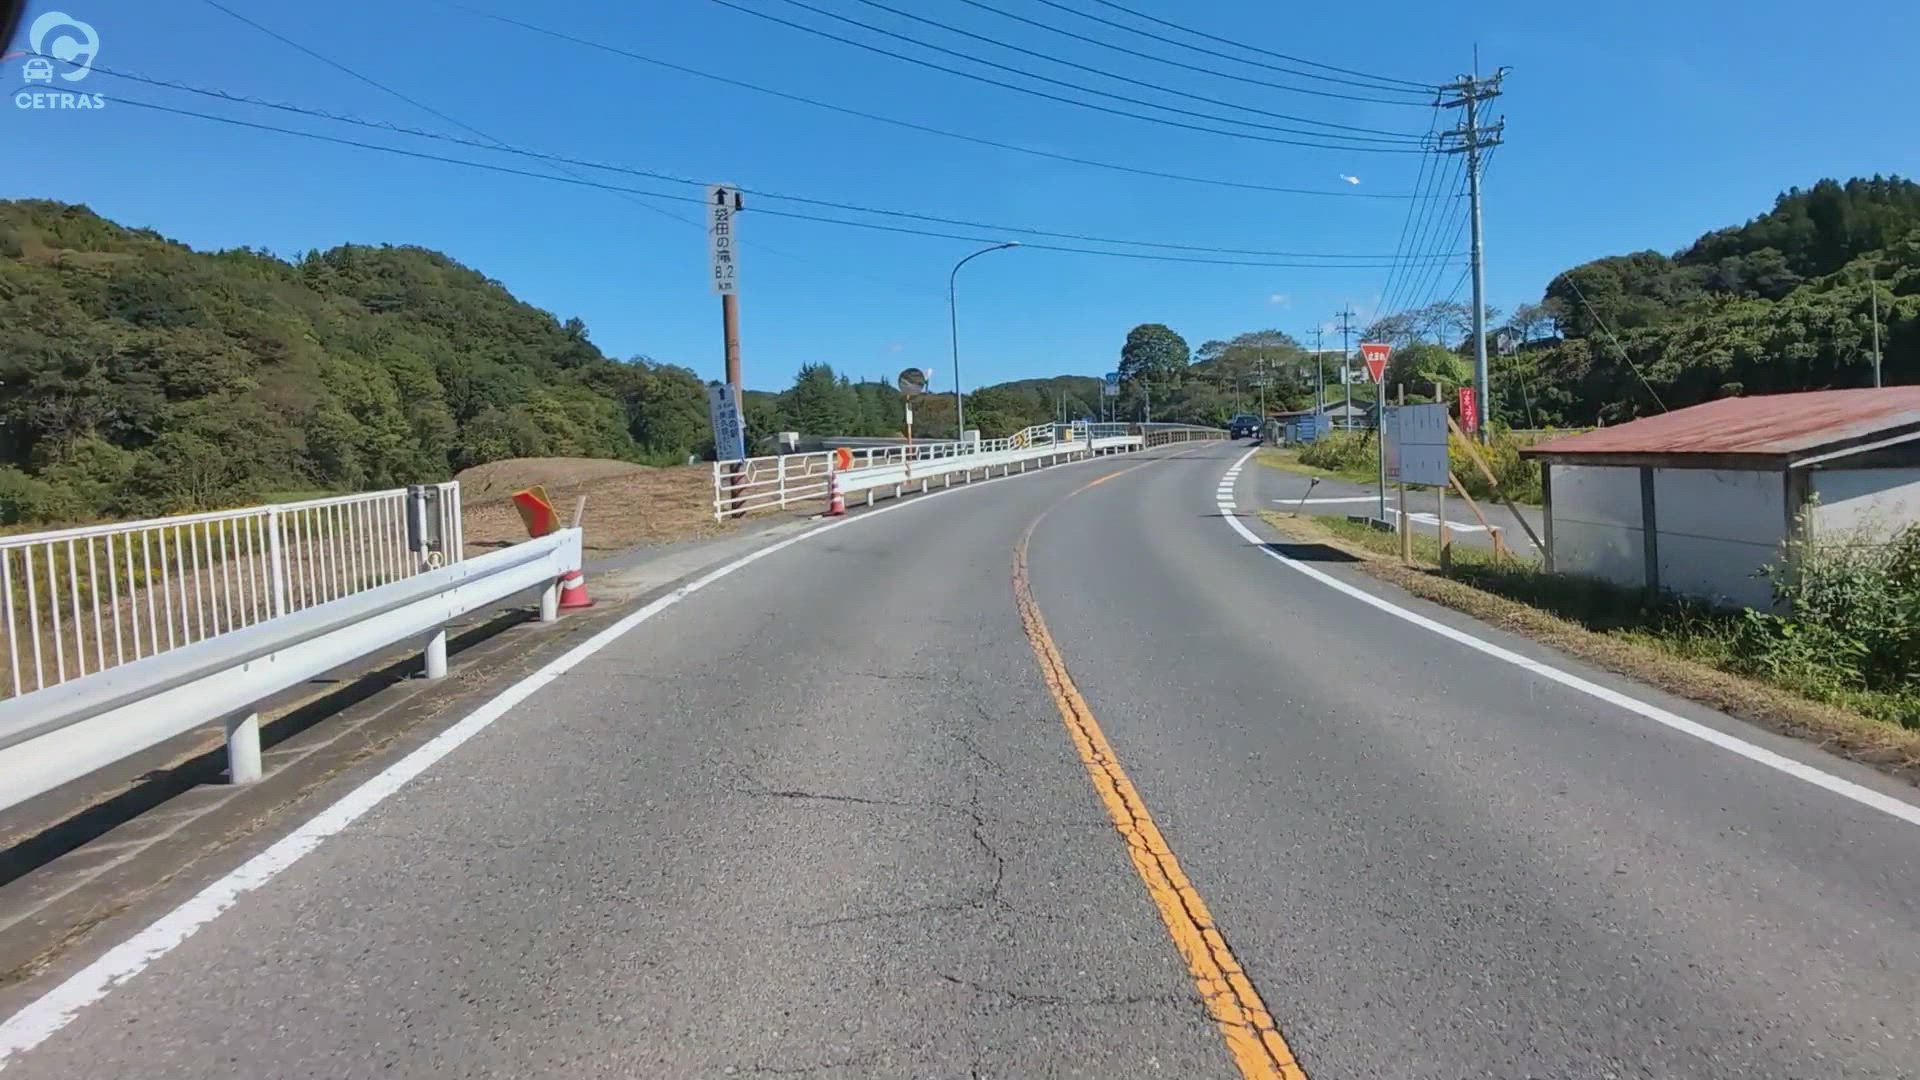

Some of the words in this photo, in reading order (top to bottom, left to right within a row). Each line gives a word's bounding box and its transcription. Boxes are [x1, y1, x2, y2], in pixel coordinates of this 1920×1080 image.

[714, 208, 731, 263] 袋田の滝
[715, 265, 734, 279] 8.2
[718, 282, 732, 290] km
